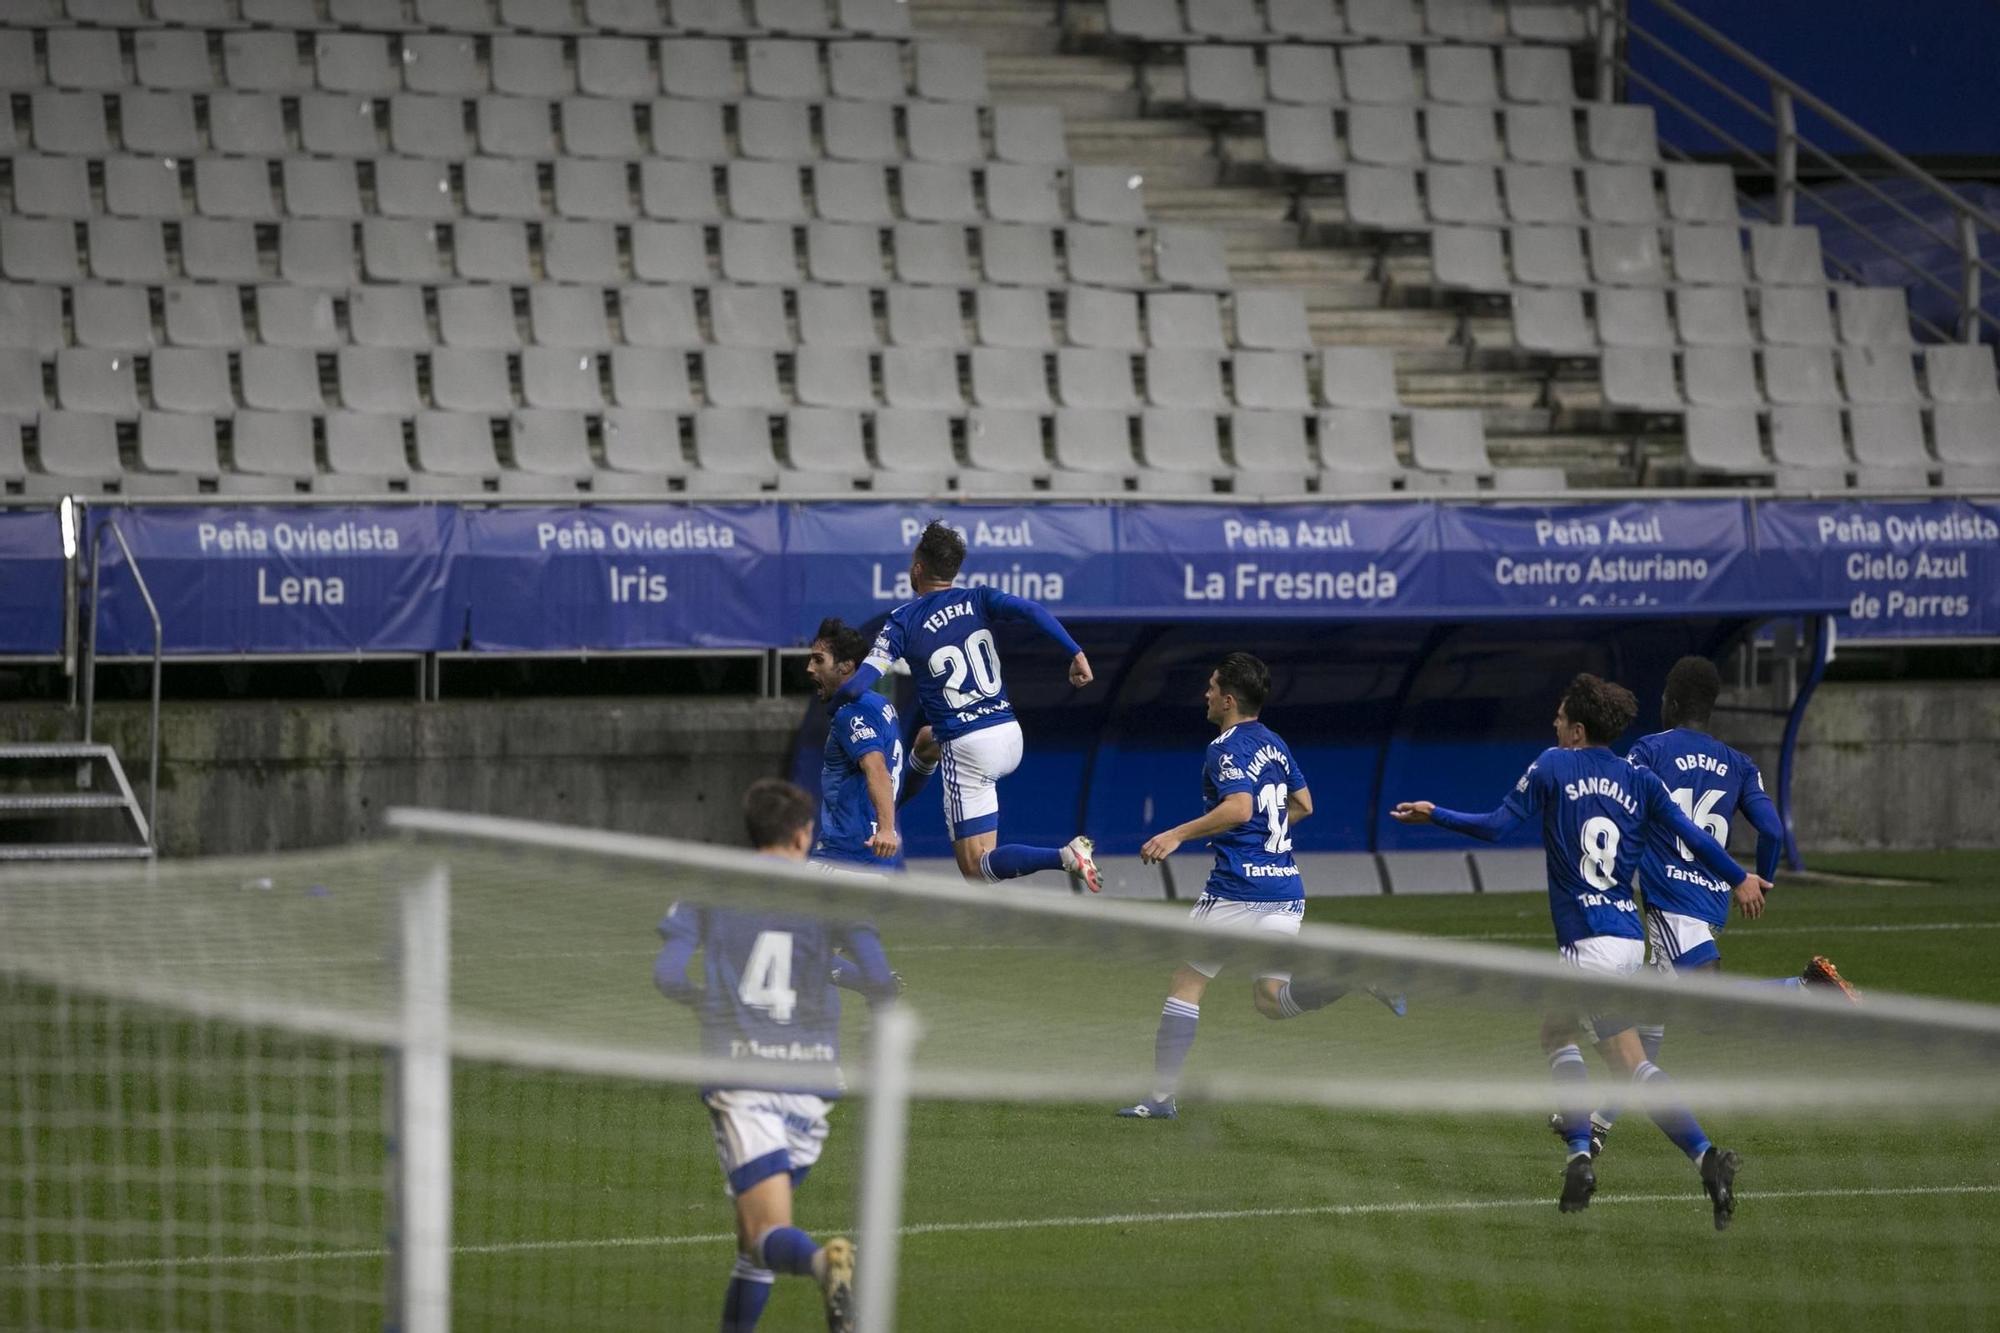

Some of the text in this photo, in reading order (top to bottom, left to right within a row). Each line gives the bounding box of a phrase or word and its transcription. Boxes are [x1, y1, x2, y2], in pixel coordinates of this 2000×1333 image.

[198, 522, 399, 551] Peña Oviedista
[537, 520, 735, 550] Peña Oviedista
[974, 519, 1033, 547] Azul
[1223, 519, 1354, 549] Peña Azul
[1535, 516, 1663, 547] Peña Azul
[1818, 511, 1999, 544] Peña Oviedista
[872, 563, 1064, 600] La squina
[1184, 562, 1397, 599] La Fresneda
[1495, 553, 1708, 585] Centro Asturiano
[1847, 551, 1967, 580] Cielo Azul
[257, 567, 345, 605] Lena
[610, 565, 668, 602] Iris
[923, 601, 975, 634] TEJERA
[1851, 590, 1969, 619] de Parres
[928, 628, 1002, 709] 20
[1675, 753, 1728, 776] OBENG
[1565, 777, 1638, 815] SANGALLI
[1258, 783, 1293, 854] 12
[1671, 788, 1728, 862] 16
[1580, 816, 1620, 891] 8
[738, 930, 797, 1025] 4
